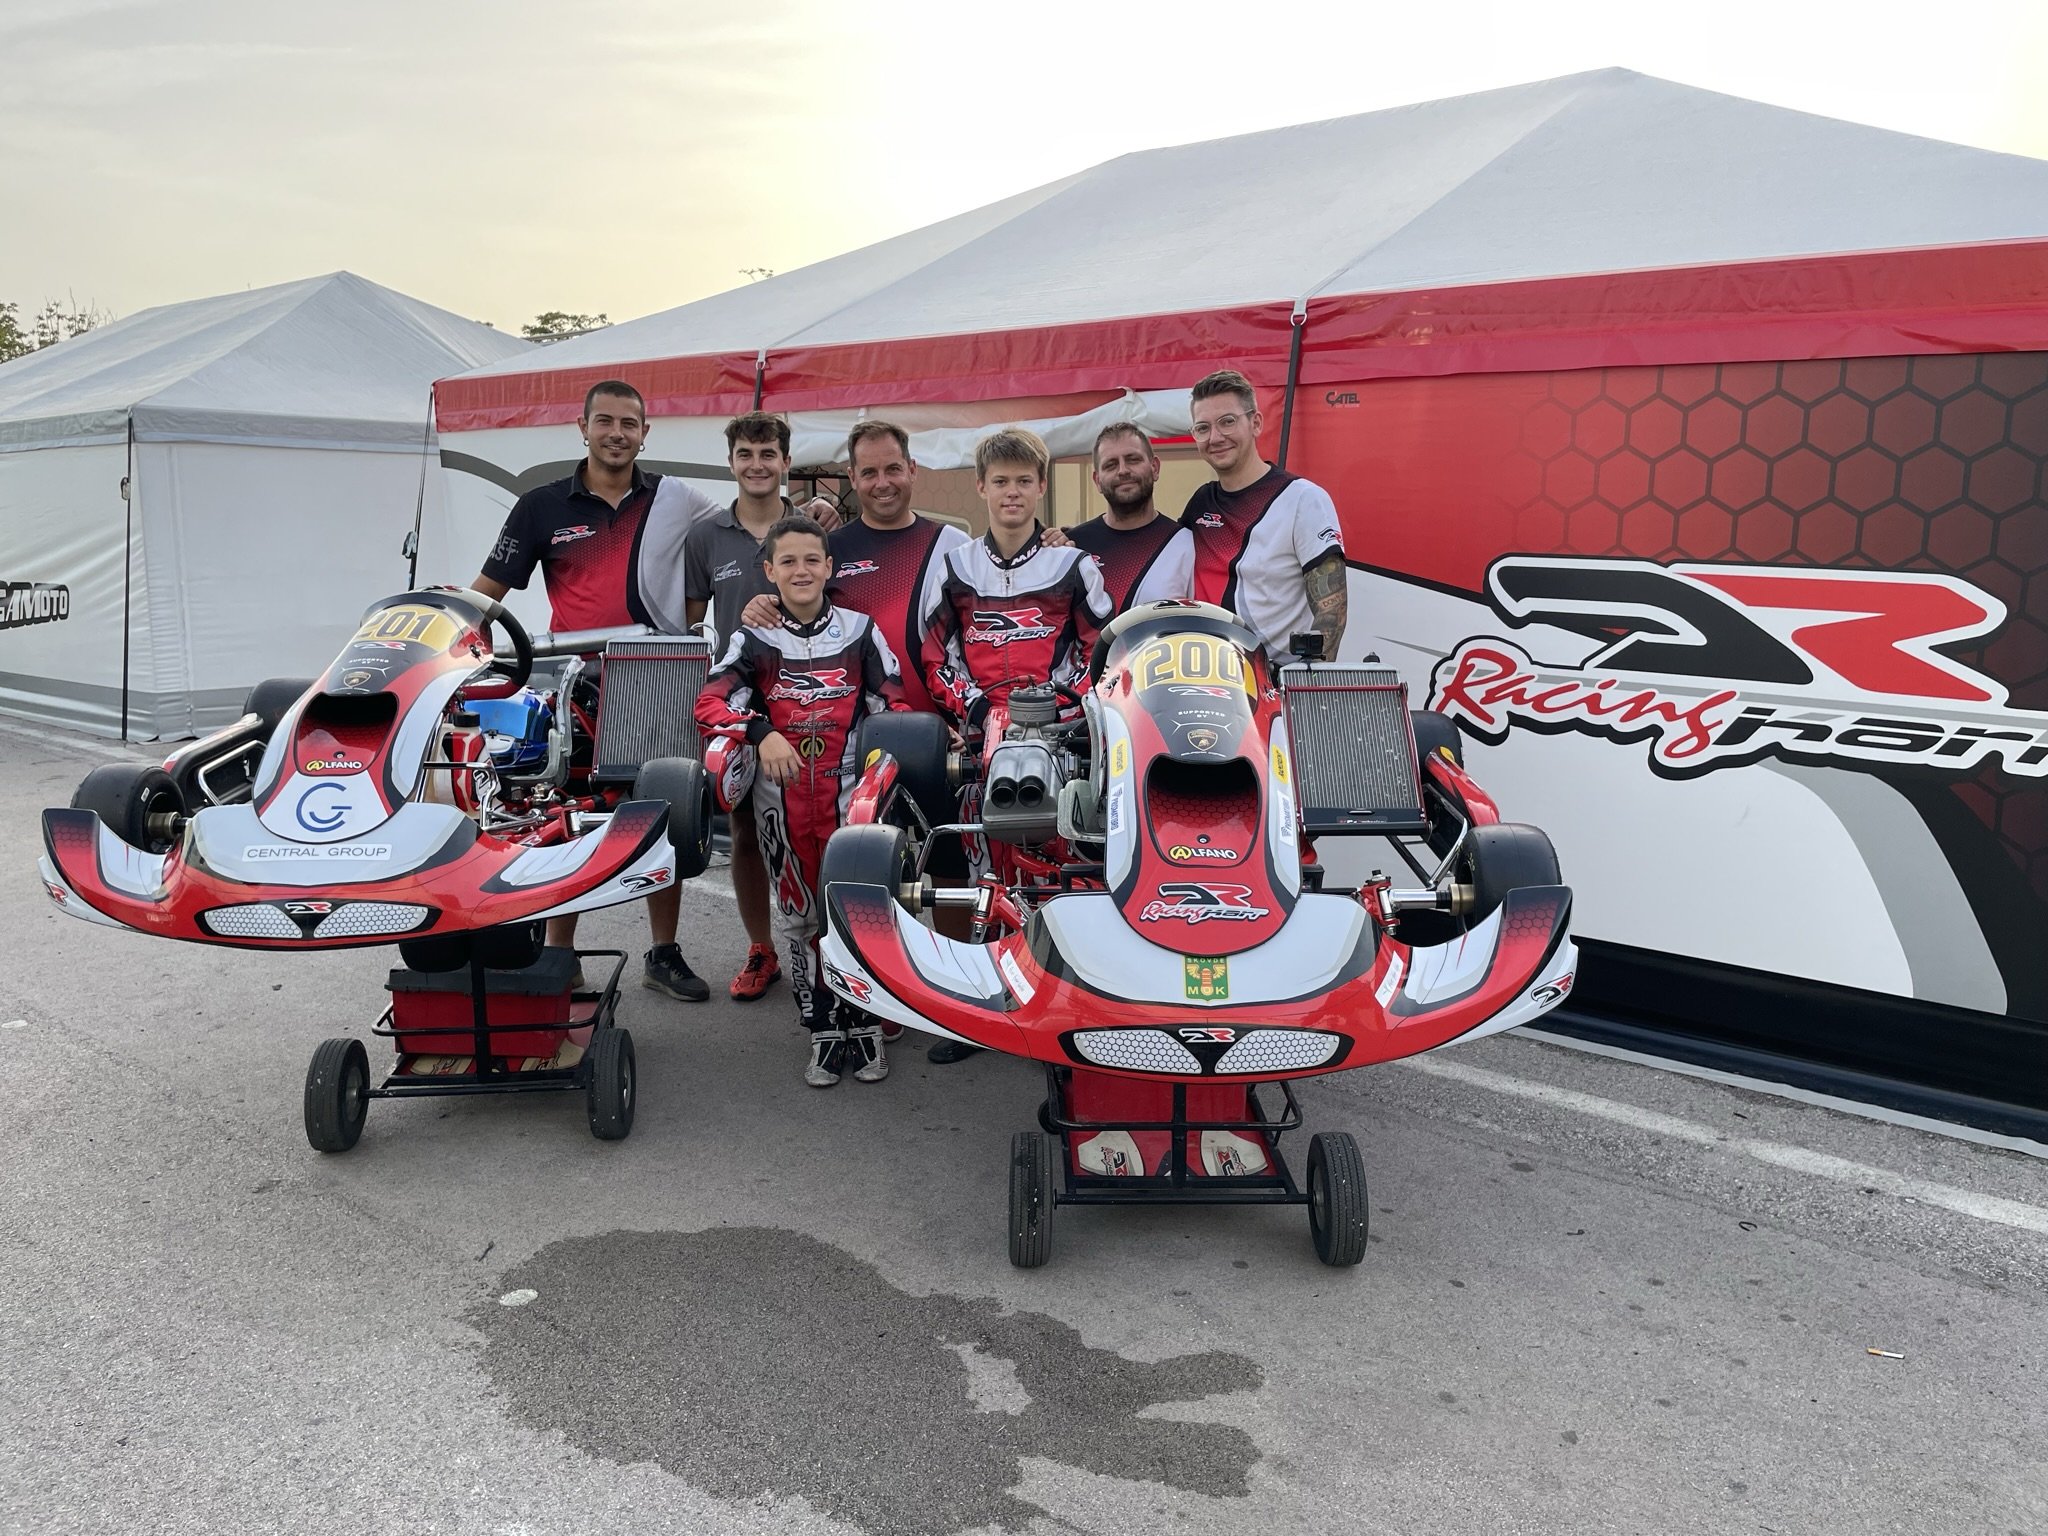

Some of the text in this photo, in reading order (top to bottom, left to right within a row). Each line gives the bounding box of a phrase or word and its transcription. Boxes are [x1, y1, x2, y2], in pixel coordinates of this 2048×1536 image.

[1142, 639, 1247, 690] 200
[1437, 648, 1738, 759] Racing
[247, 846, 387, 858] CENTRAL GROUP
[1169, 845, 1238, 860] ALFANO
